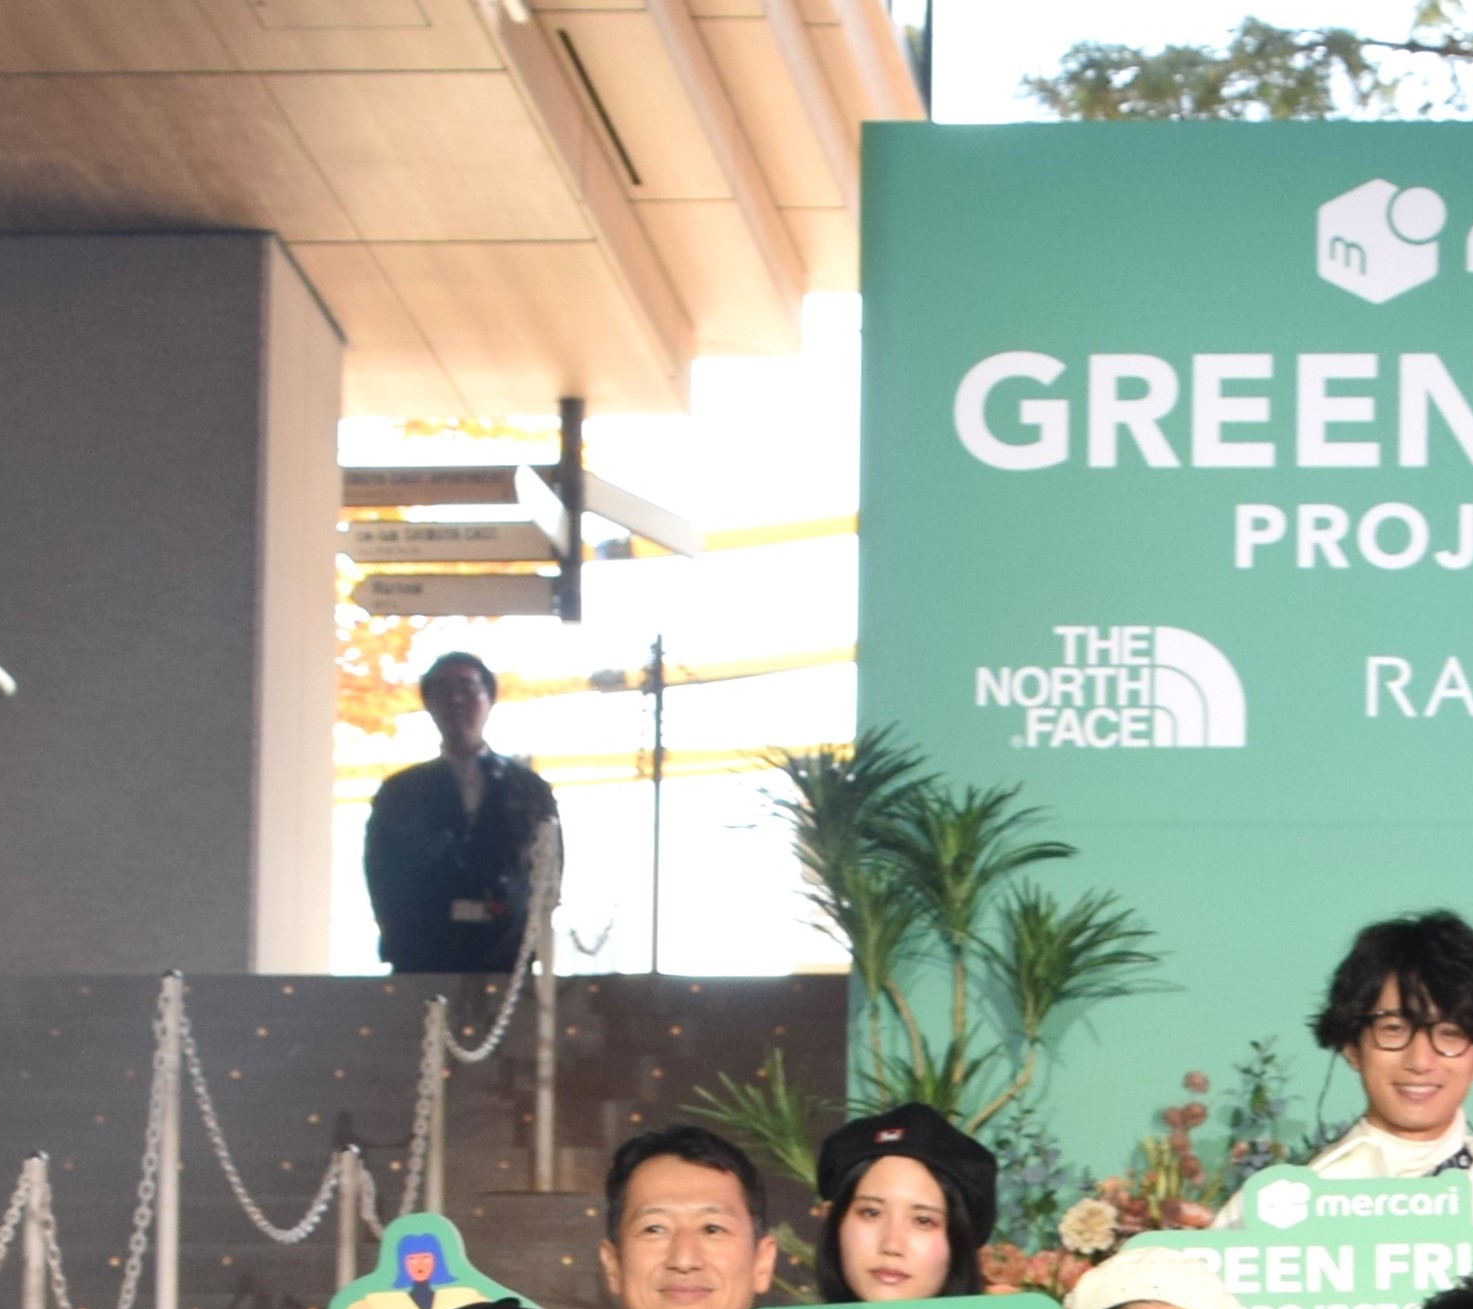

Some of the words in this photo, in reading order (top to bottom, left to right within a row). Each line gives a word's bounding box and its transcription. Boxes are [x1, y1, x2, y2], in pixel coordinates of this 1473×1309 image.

[1053, 624, 1150, 666] THE
[975, 665, 1150, 707] NORTH
[1027, 706, 1150, 748] FACE
[1315, 1186, 1459, 1216] mercari
